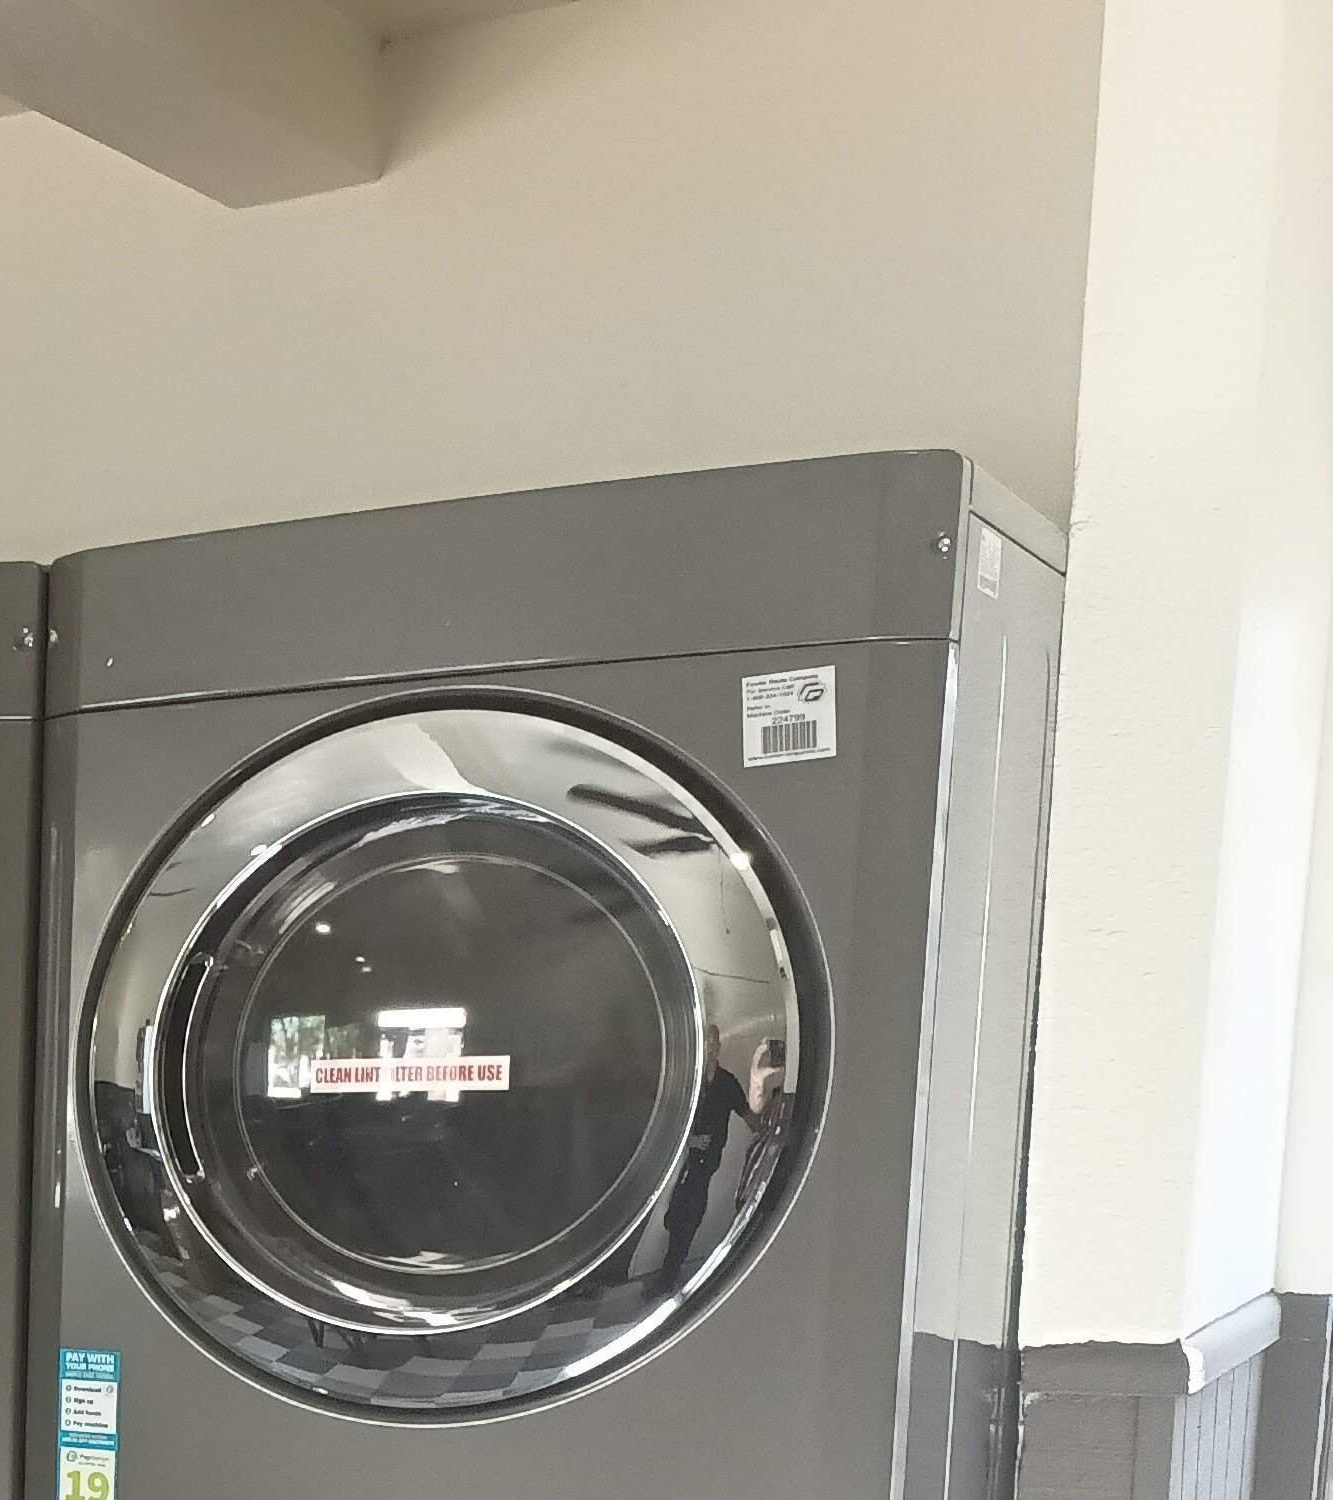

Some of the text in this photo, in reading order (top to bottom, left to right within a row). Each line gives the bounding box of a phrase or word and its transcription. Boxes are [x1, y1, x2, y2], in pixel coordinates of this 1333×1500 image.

[315, 1065, 502, 1083] CLEAN LINT ILTER BEFORE USE
[66, 1352, 114, 1365] PAY WITH
[66, 1363, 114, 1372] YOUR PHONE
